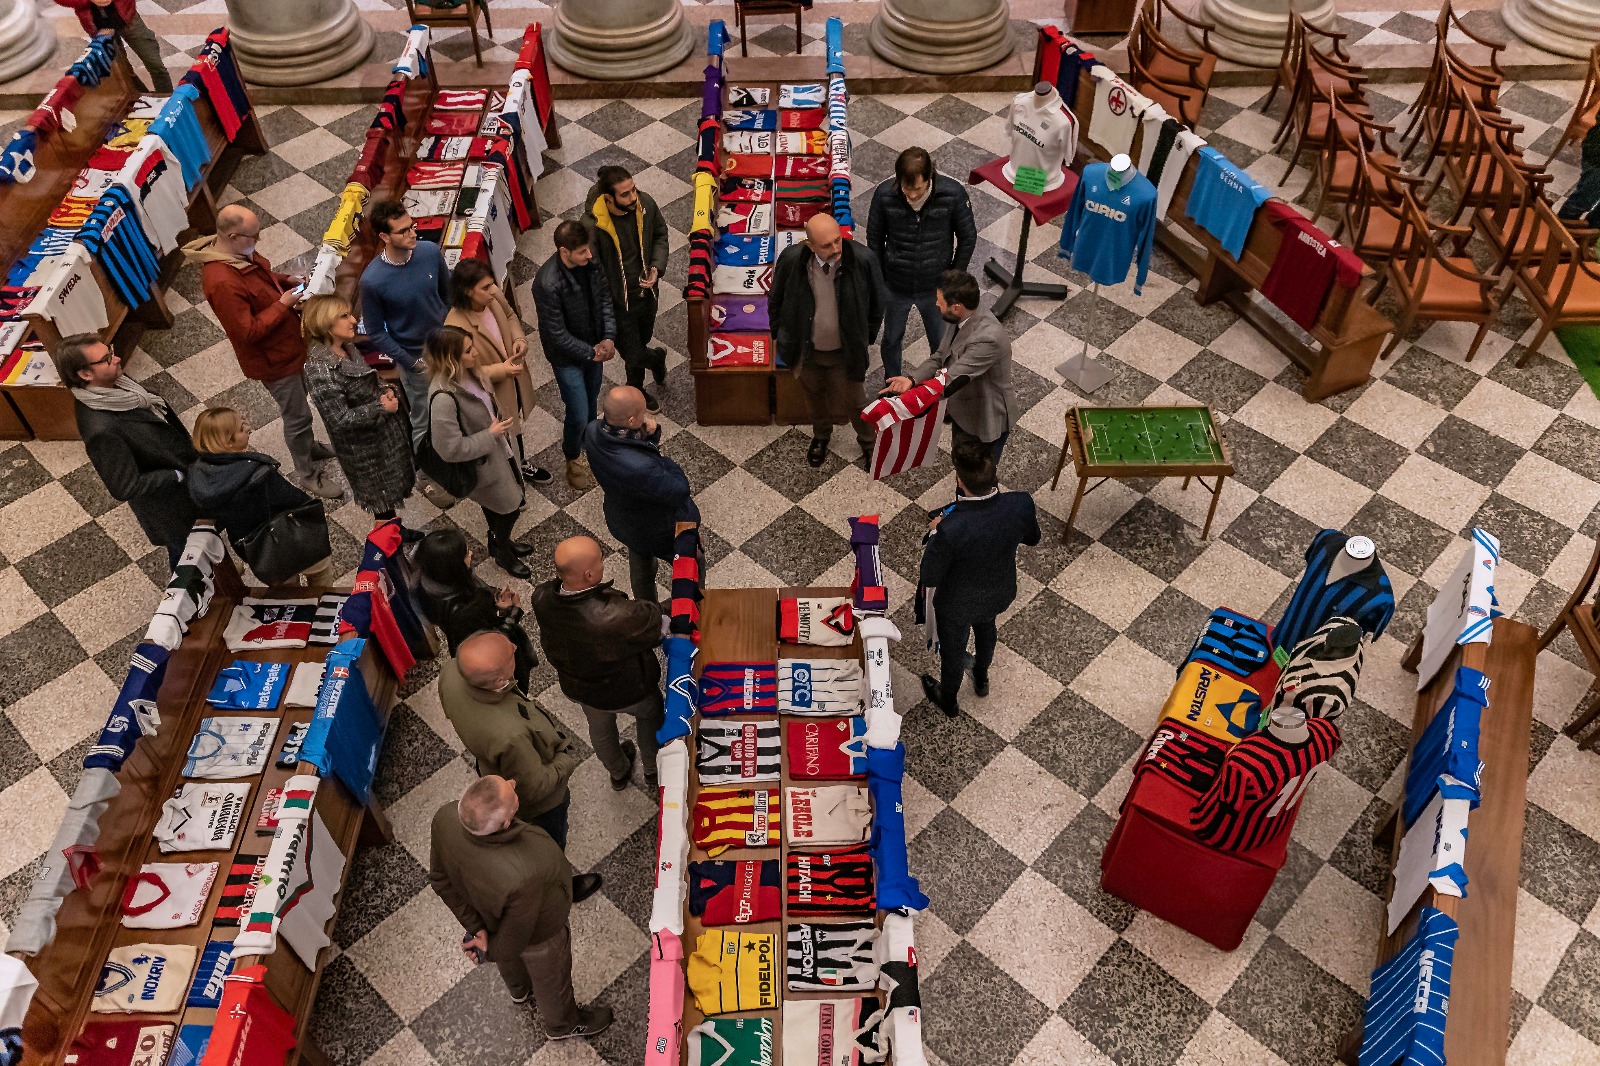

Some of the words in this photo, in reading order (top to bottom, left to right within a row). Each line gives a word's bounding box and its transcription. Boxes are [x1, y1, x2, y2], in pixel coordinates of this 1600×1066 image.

[1084, 199, 1128, 223] CIRIO
[758, 236, 771, 265] PHILCO
[58, 272, 82, 305] SWEDA
[255, 663, 283, 710] watergate
[1186, 666, 1213, 723] ARISTON
[734, 742, 742, 759] olio
[743, 724, 755, 759] GIORGIO
[805, 722, 820, 776] CARIFANO
[744, 761, 755, 777] SAN
[226, 796, 244, 835] TORTONA
[257, 788, 278, 827] SALUMI
[791, 789, 814, 838] LEBOLE
[276, 822, 307, 901] OLIMPIA
[798, 856, 811, 902] HITACHI
[189, 898, 203, 921] CASSA
[203, 950, 231, 999] mita
[758, 935, 771, 1007] FIDELPOL
[820, 1005, 833, 1029] VINI
